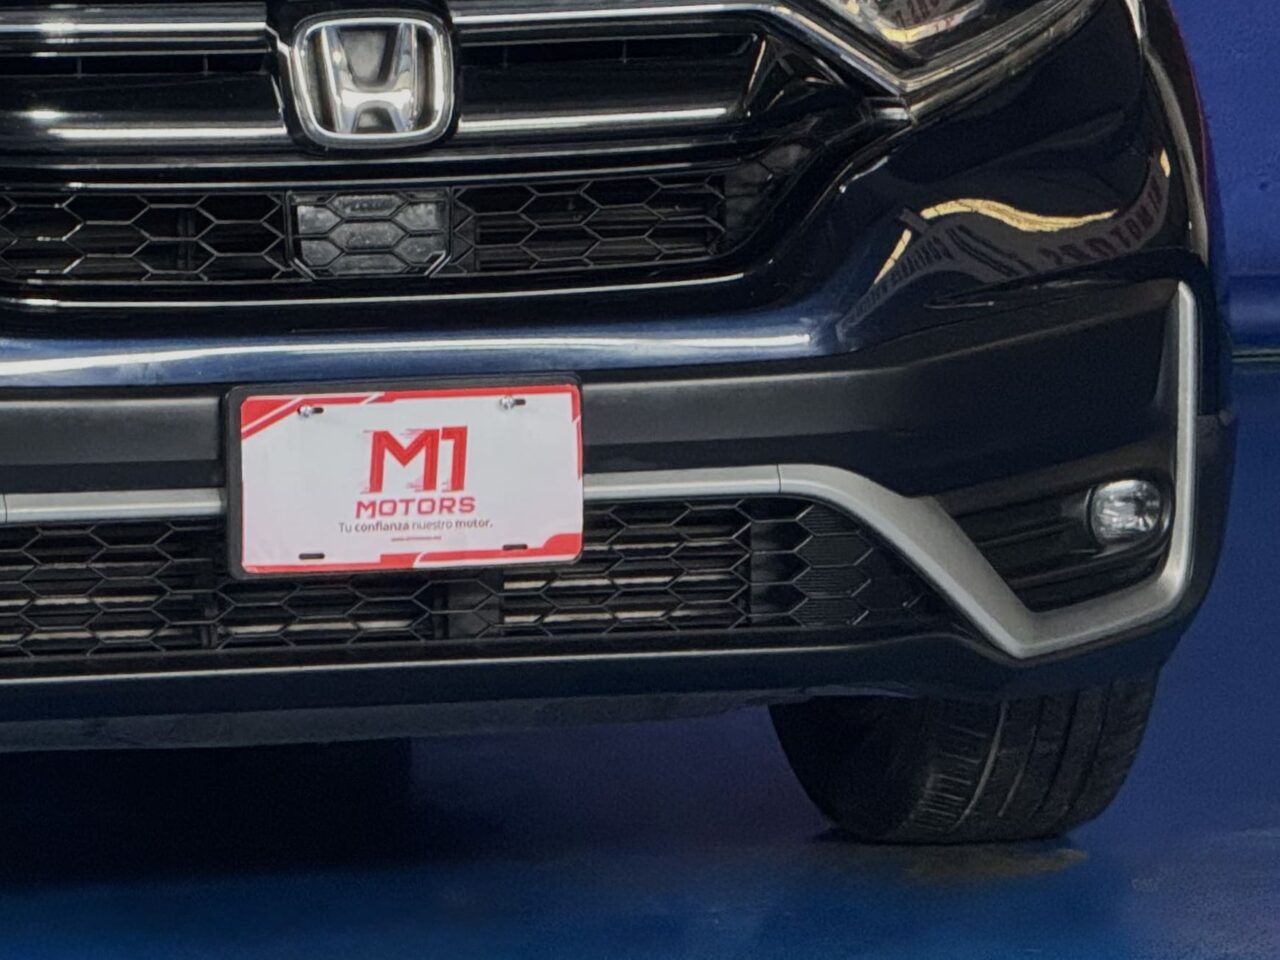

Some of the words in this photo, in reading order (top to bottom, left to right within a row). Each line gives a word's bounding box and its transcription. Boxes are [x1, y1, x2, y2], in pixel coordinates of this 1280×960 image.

[361, 425, 469, 494] M1
[355, 496, 477, 519] MOTORS
[338, 522, 352, 533] Tu
[354, 520, 410, 533] confianza
[411, 519, 453, 531] nuestro
